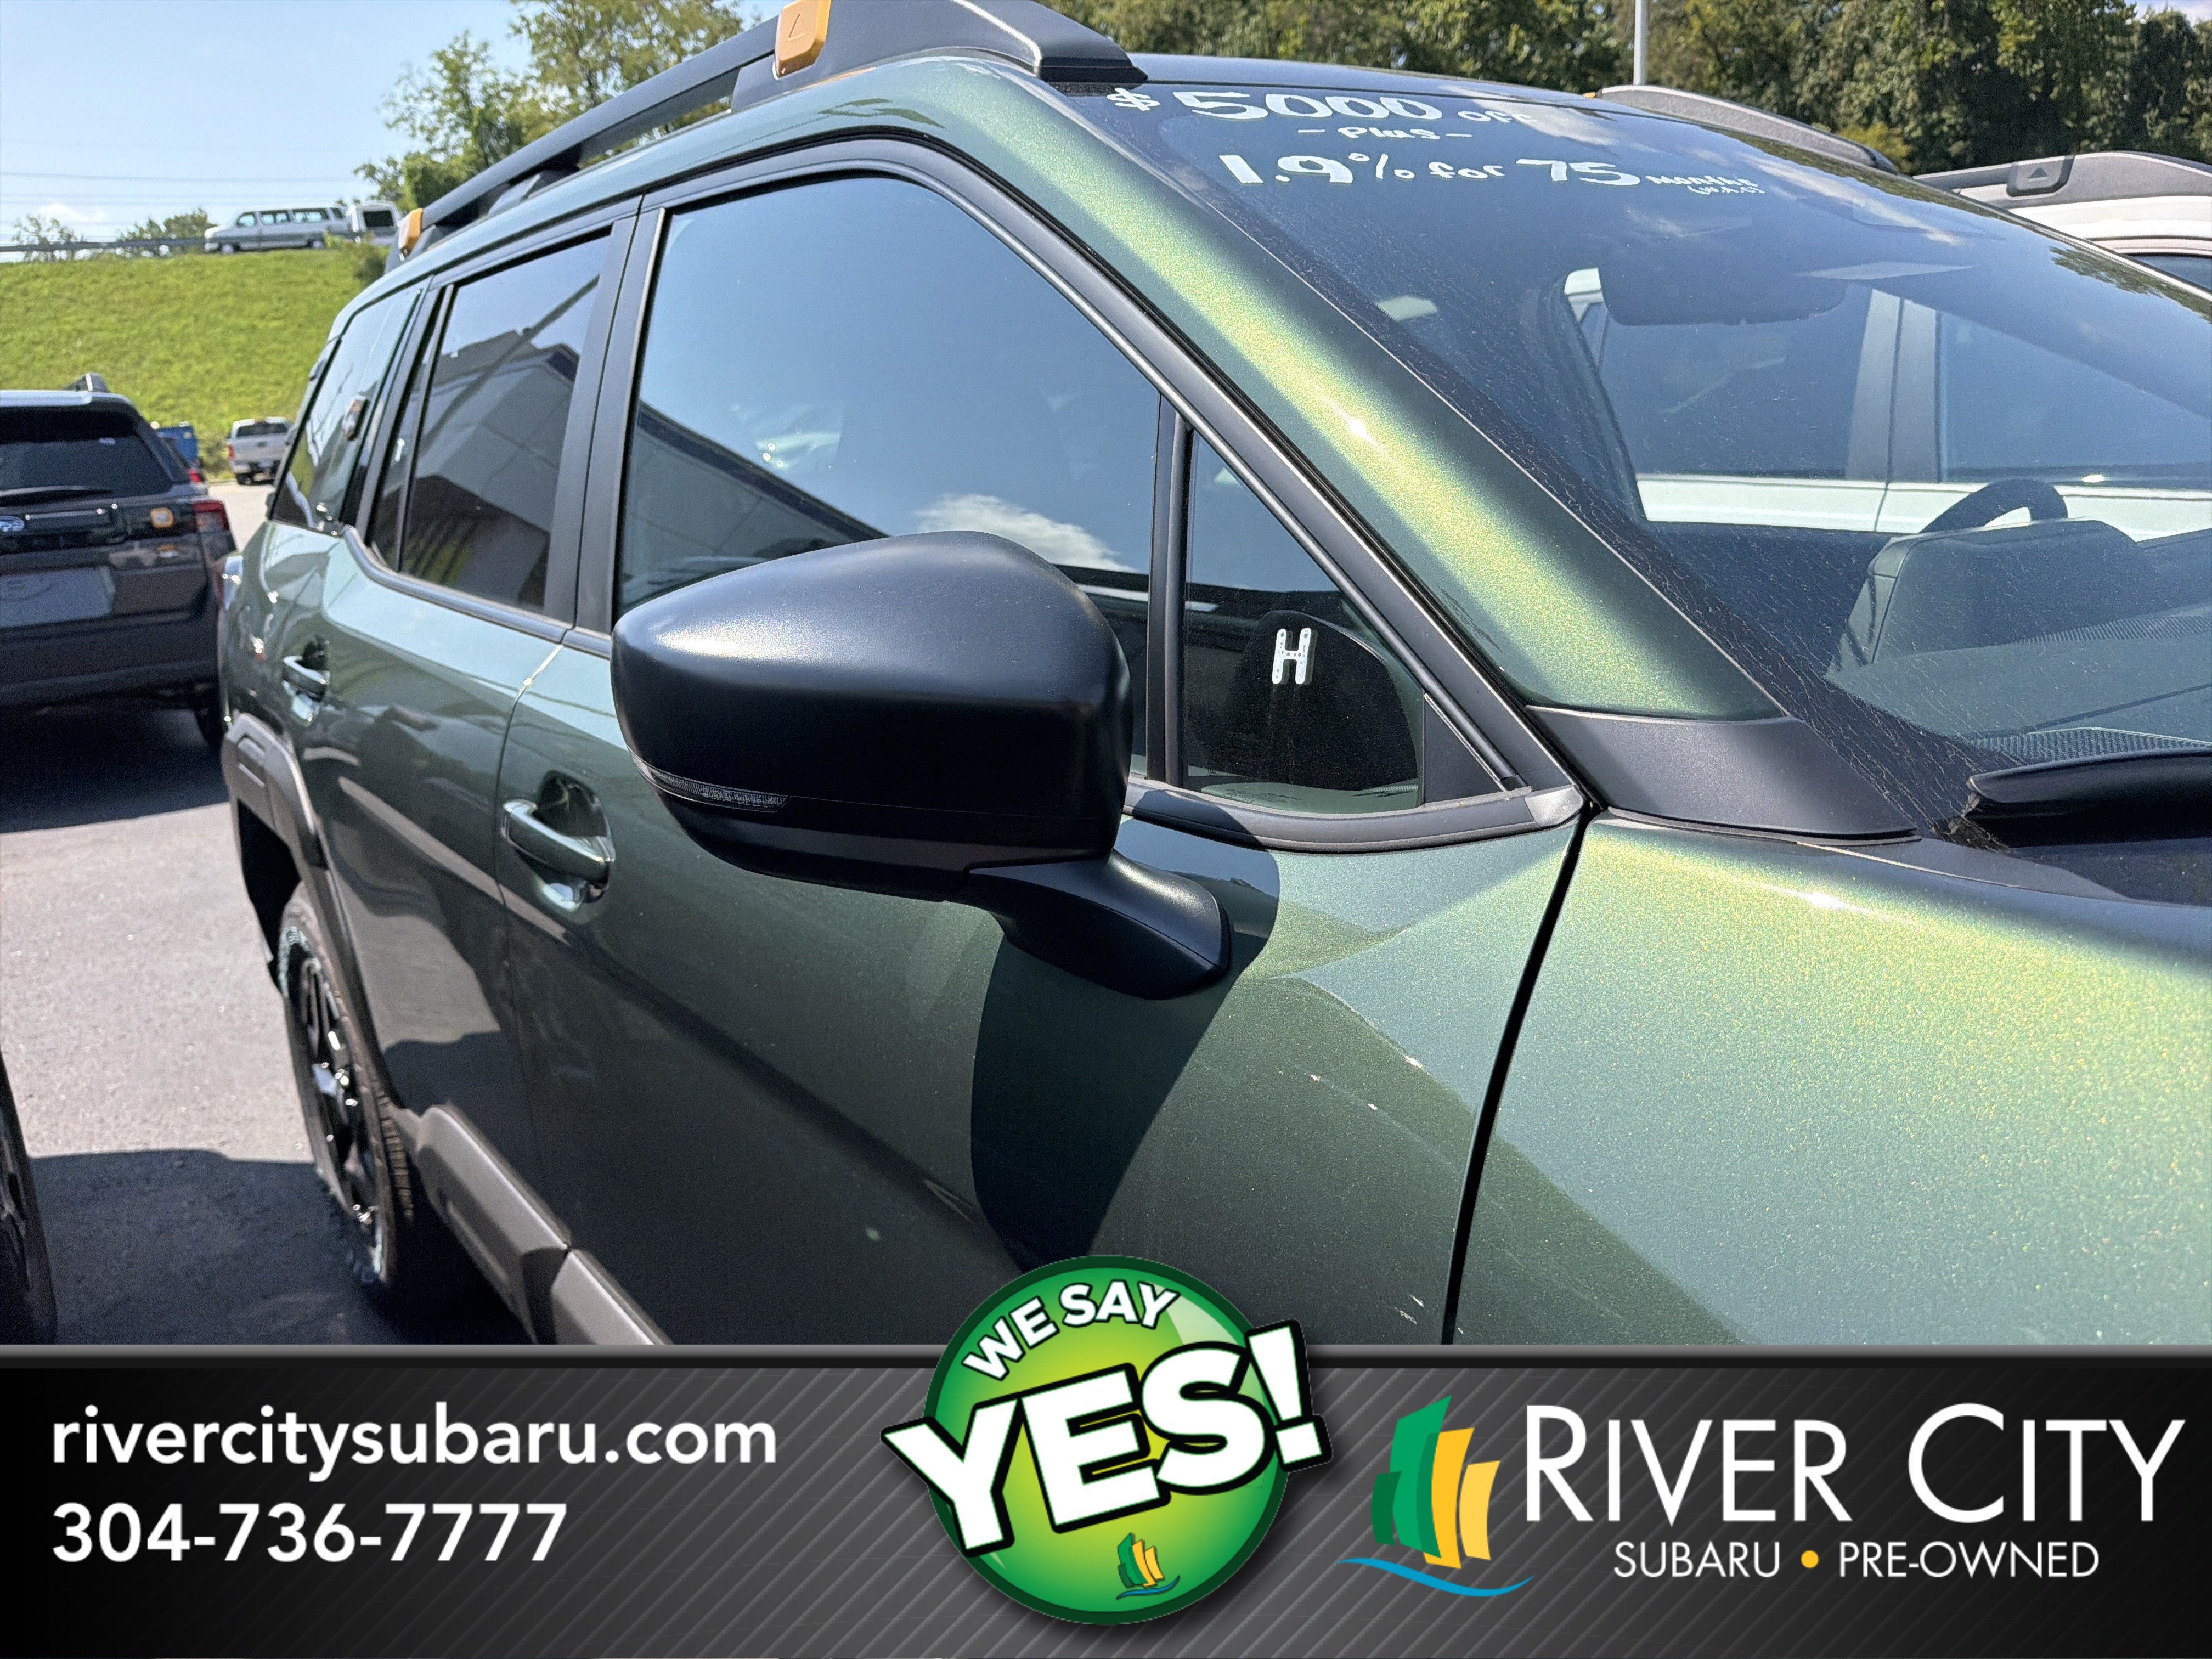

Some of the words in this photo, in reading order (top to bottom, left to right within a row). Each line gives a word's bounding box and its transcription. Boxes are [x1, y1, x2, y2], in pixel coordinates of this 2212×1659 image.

[1428, 162, 1505, 178] for
[1515, 159, 1640, 185] 75
[1272, 628, 1312, 685] H
